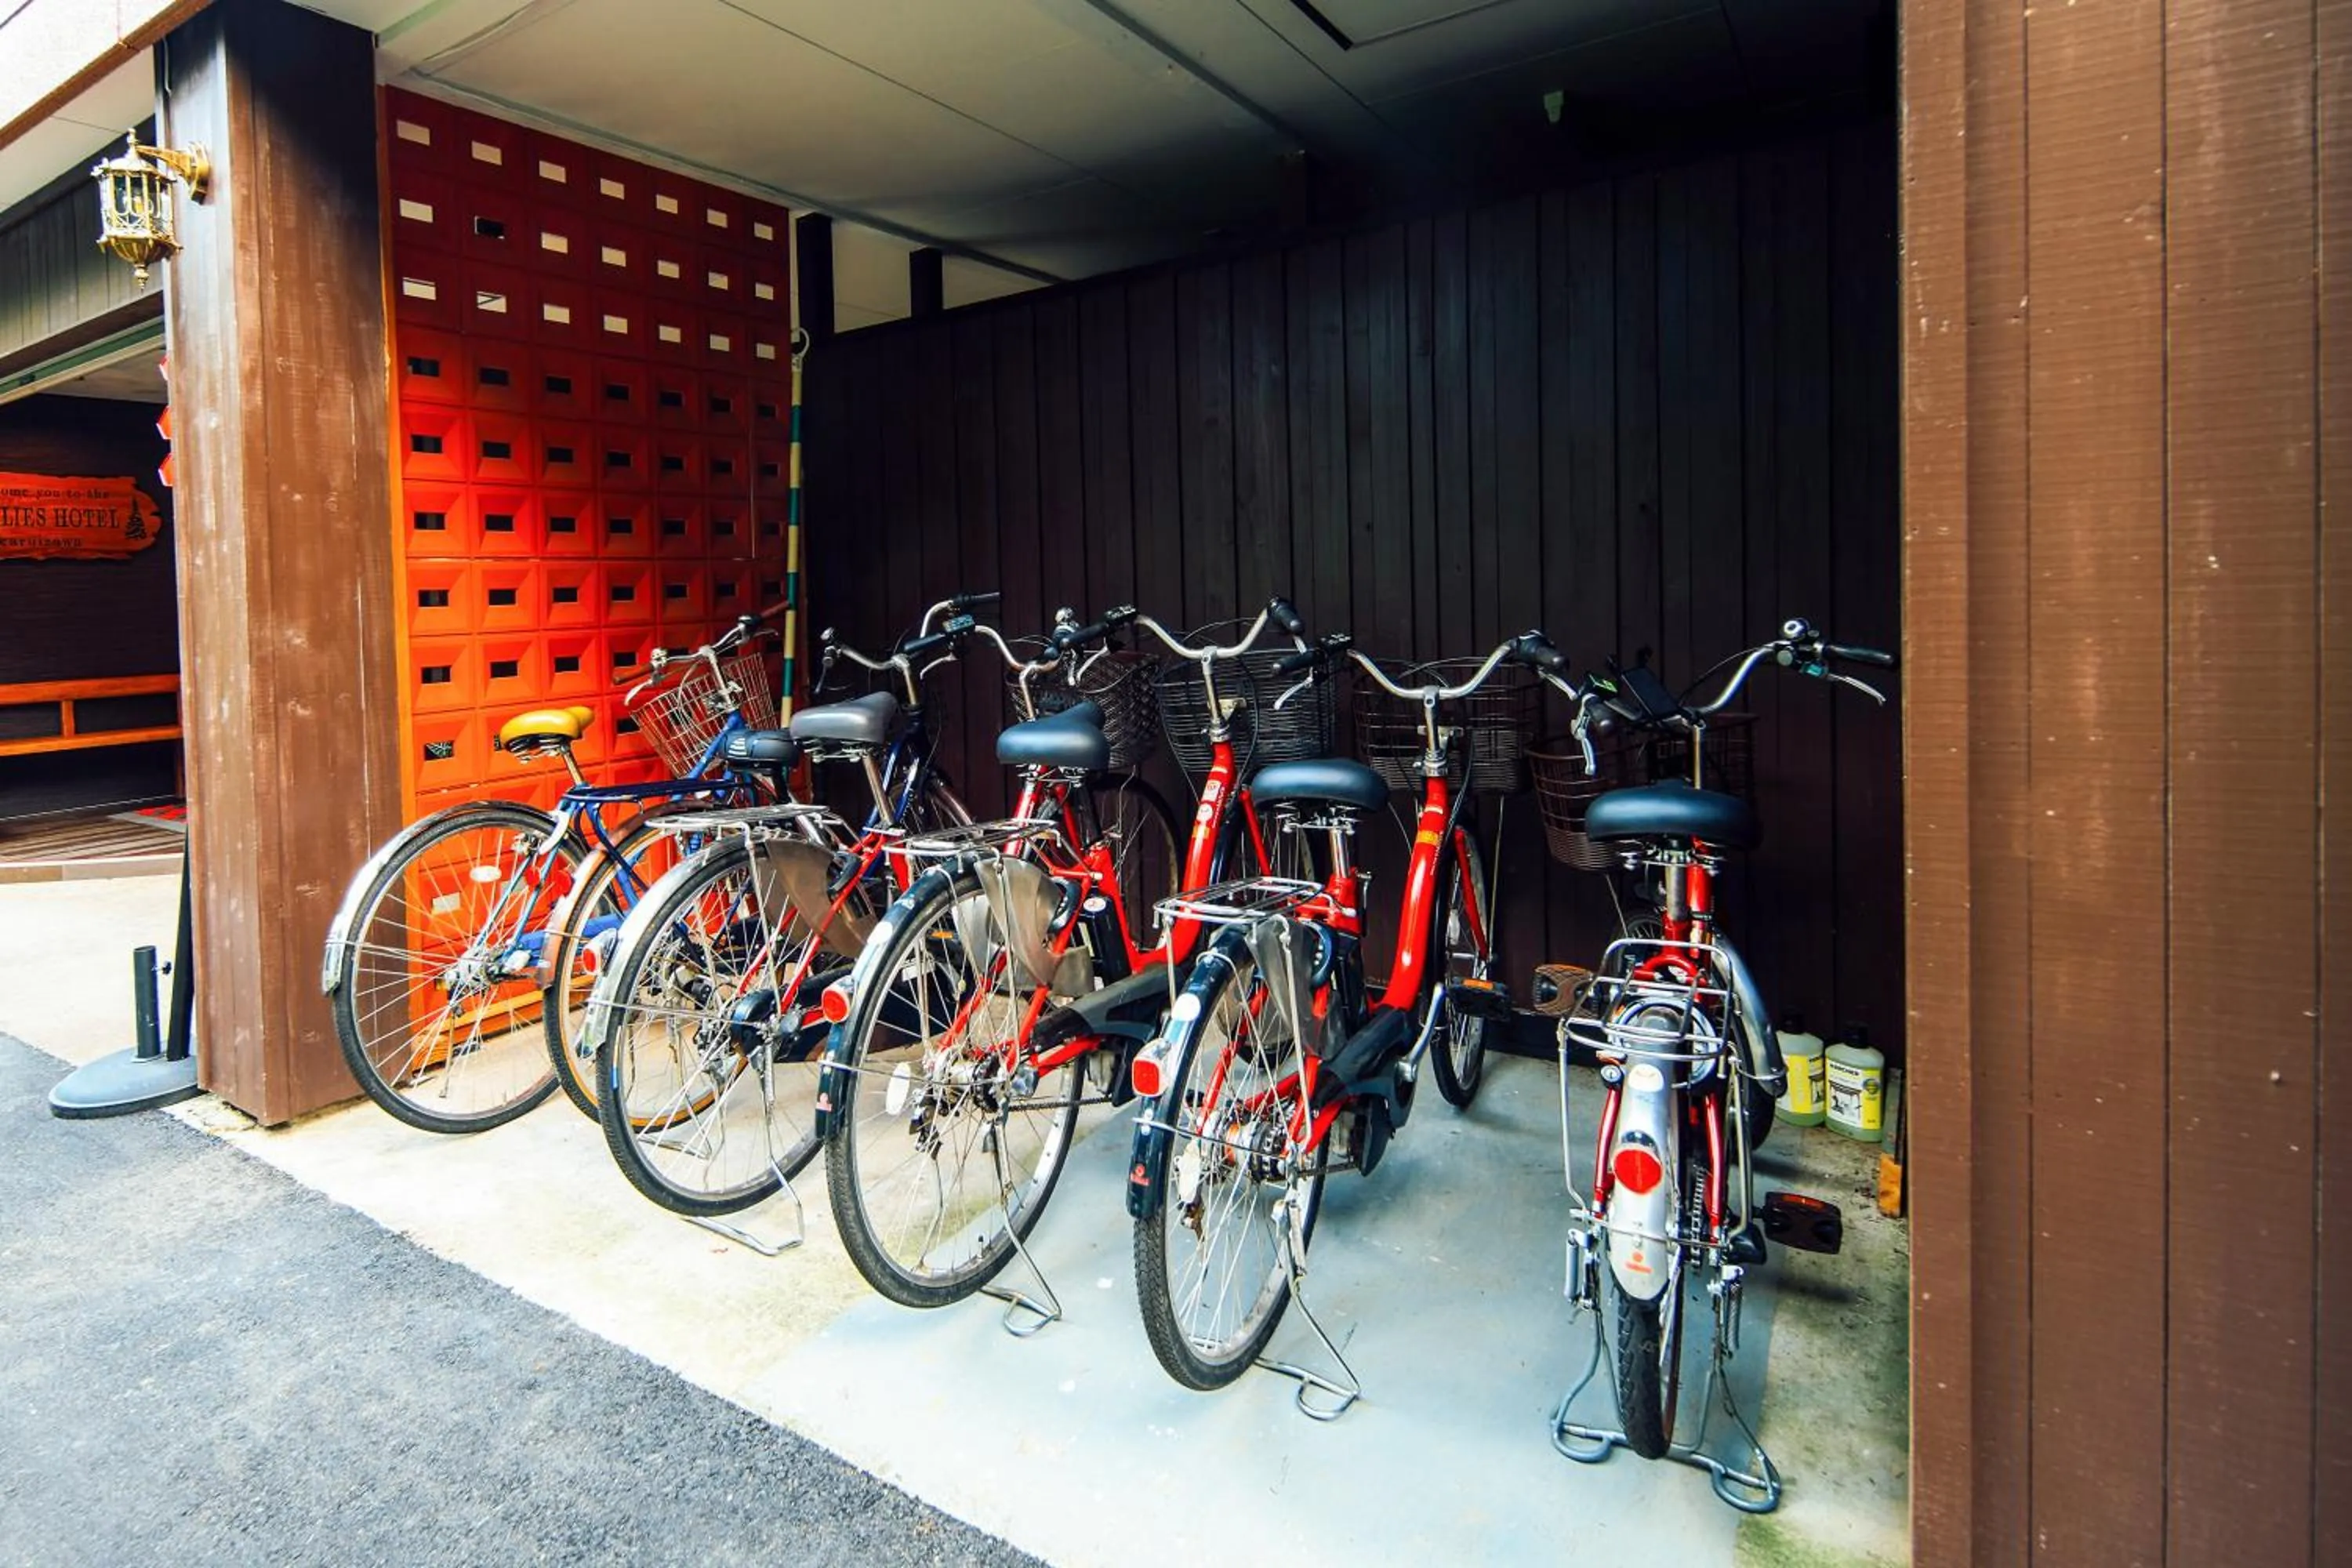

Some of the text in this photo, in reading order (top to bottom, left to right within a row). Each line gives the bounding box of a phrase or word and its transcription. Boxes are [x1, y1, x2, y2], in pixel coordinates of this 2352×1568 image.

[37, 489, 60, 499] you
[87, 488, 110, 499] the
[54, 508, 119, 528] HOTEL
